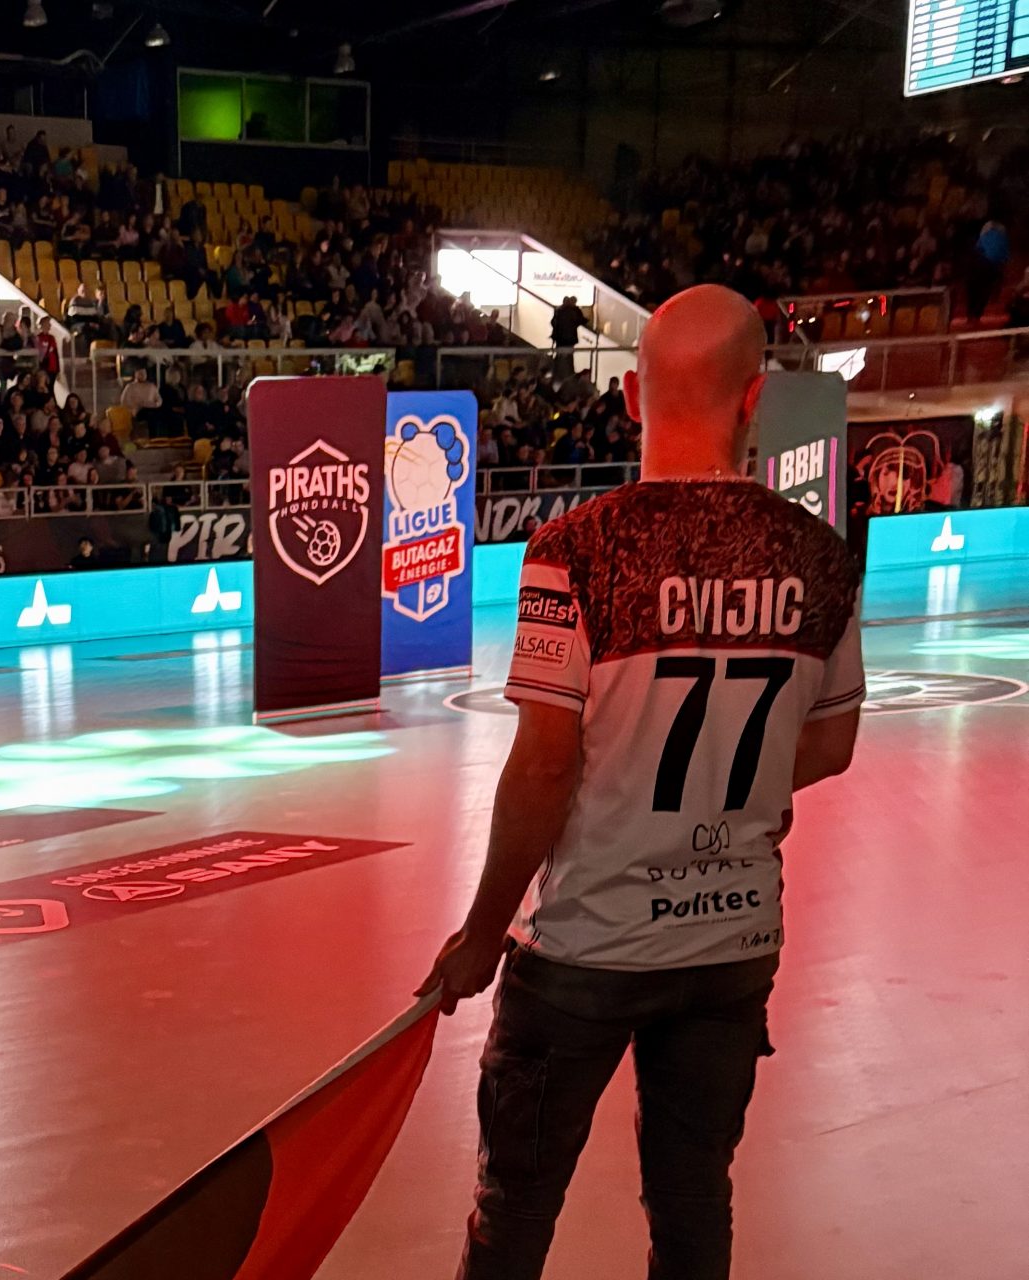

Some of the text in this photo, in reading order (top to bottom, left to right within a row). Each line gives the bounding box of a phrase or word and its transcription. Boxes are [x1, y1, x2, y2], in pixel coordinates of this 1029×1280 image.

[779, 439, 825, 491] BBH
[269, 463, 370, 510] PIRATHS
[394, 503, 452, 536] LIGUE
[391, 535, 455, 570] BUTAGAZ
[659, 576, 805, 637] CVIJIC
[515, 635, 566, 658] ALSACE
[651, 656, 795, 813] 77
[165, 840, 340, 882] SANY
[651, 889, 761, 921] Politec
